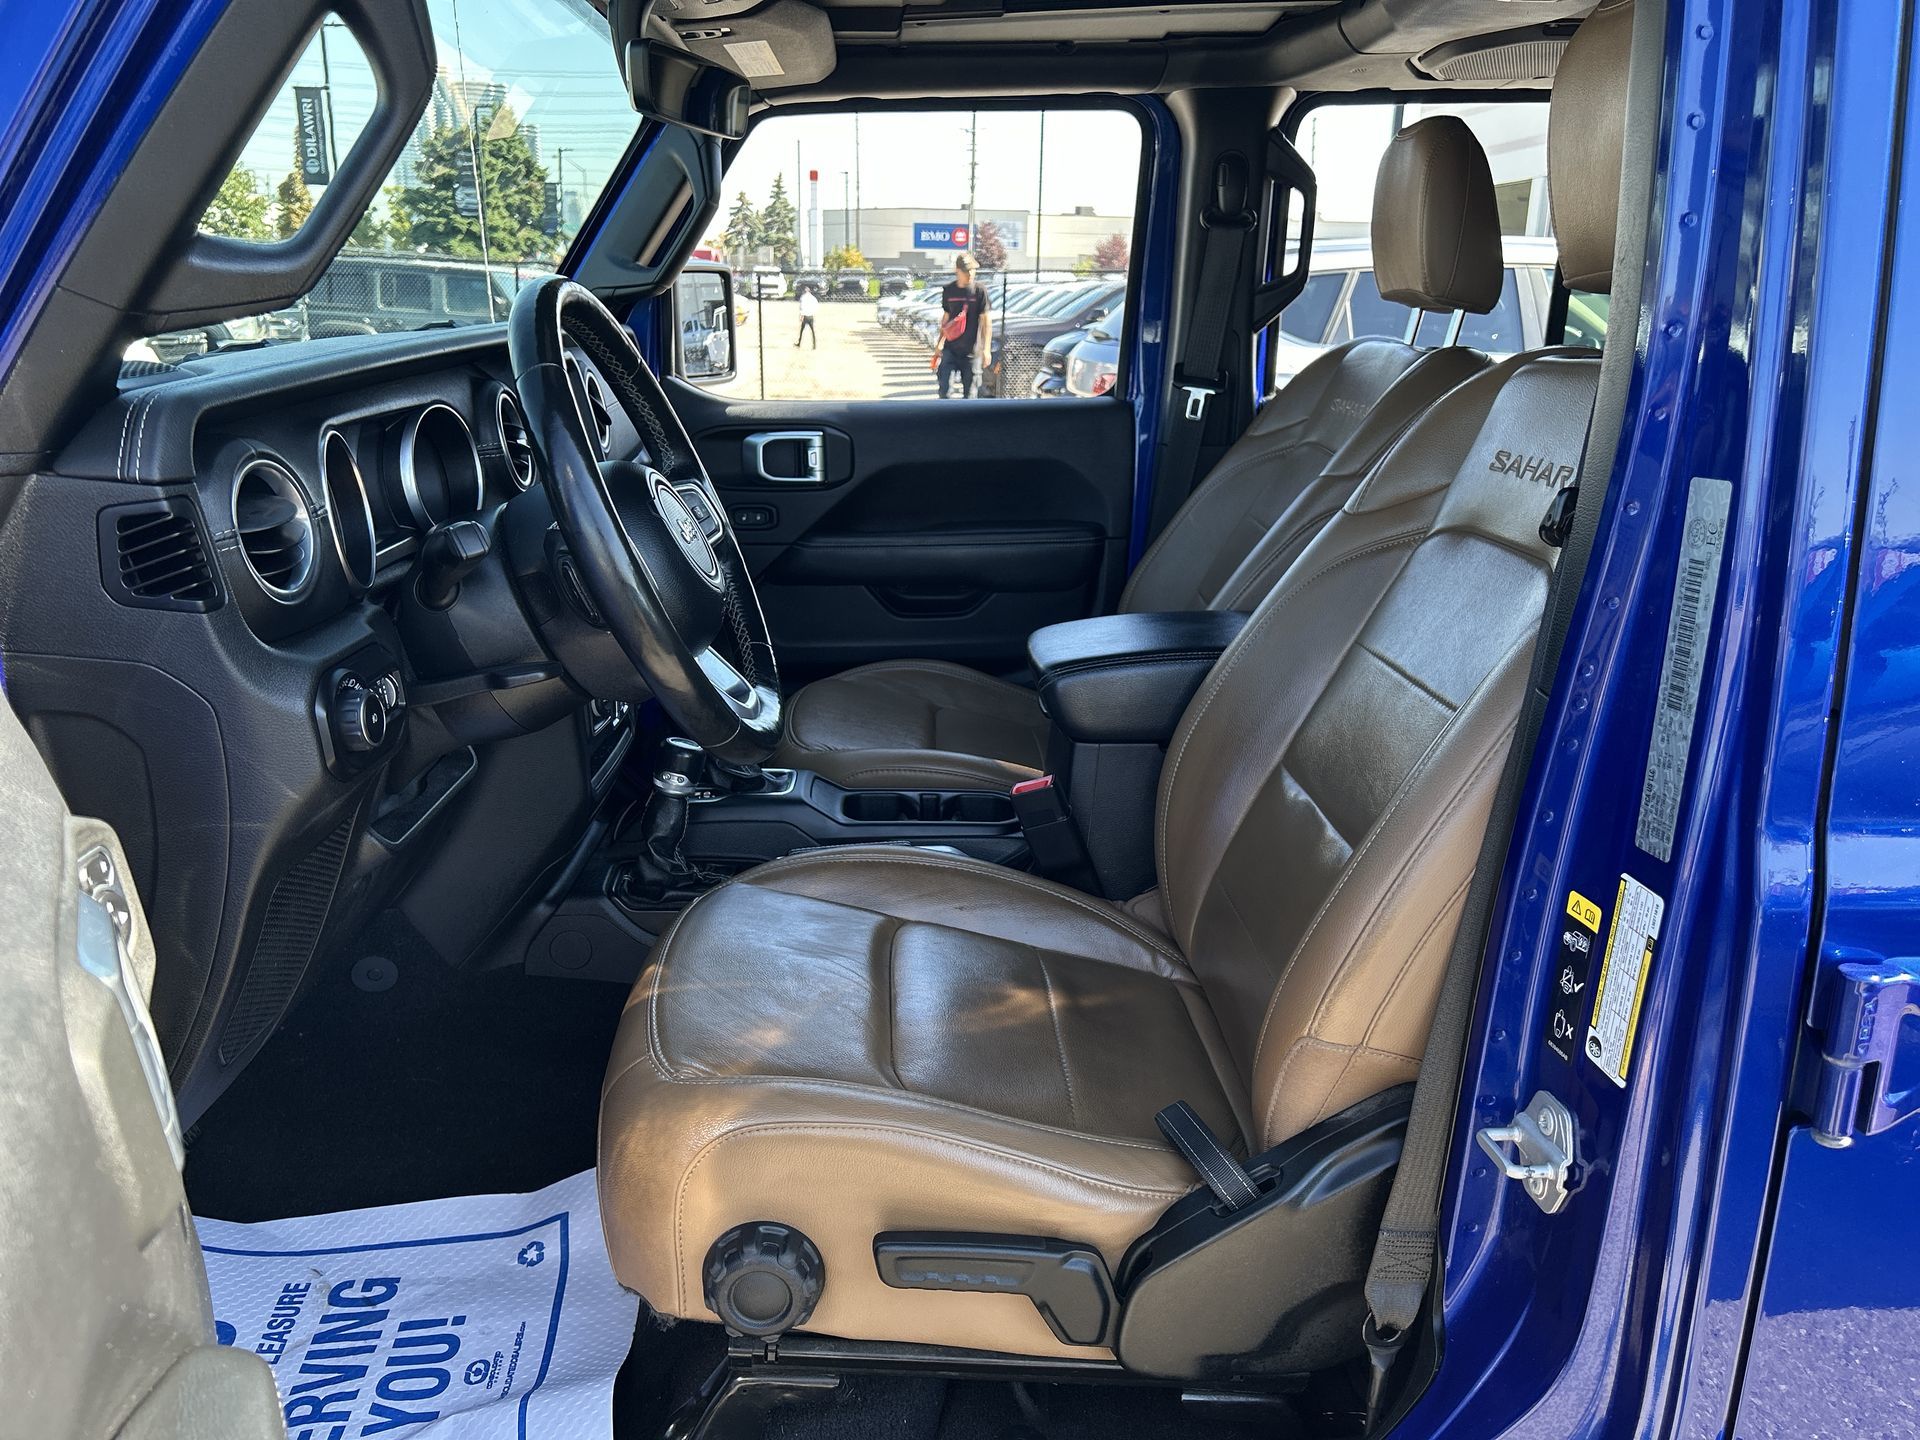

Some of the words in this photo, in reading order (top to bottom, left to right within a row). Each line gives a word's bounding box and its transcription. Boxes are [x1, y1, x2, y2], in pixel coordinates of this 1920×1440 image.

[301, 97, 319, 158] DILAWRI
[920, 230, 951, 242] BMO
[1488, 450, 1575, 490] SAHAR
[1705, 522, 1718, 546] EC
[255, 1282, 312, 1365] LEASURE
[360, 1315, 467, 1438] YOU!
